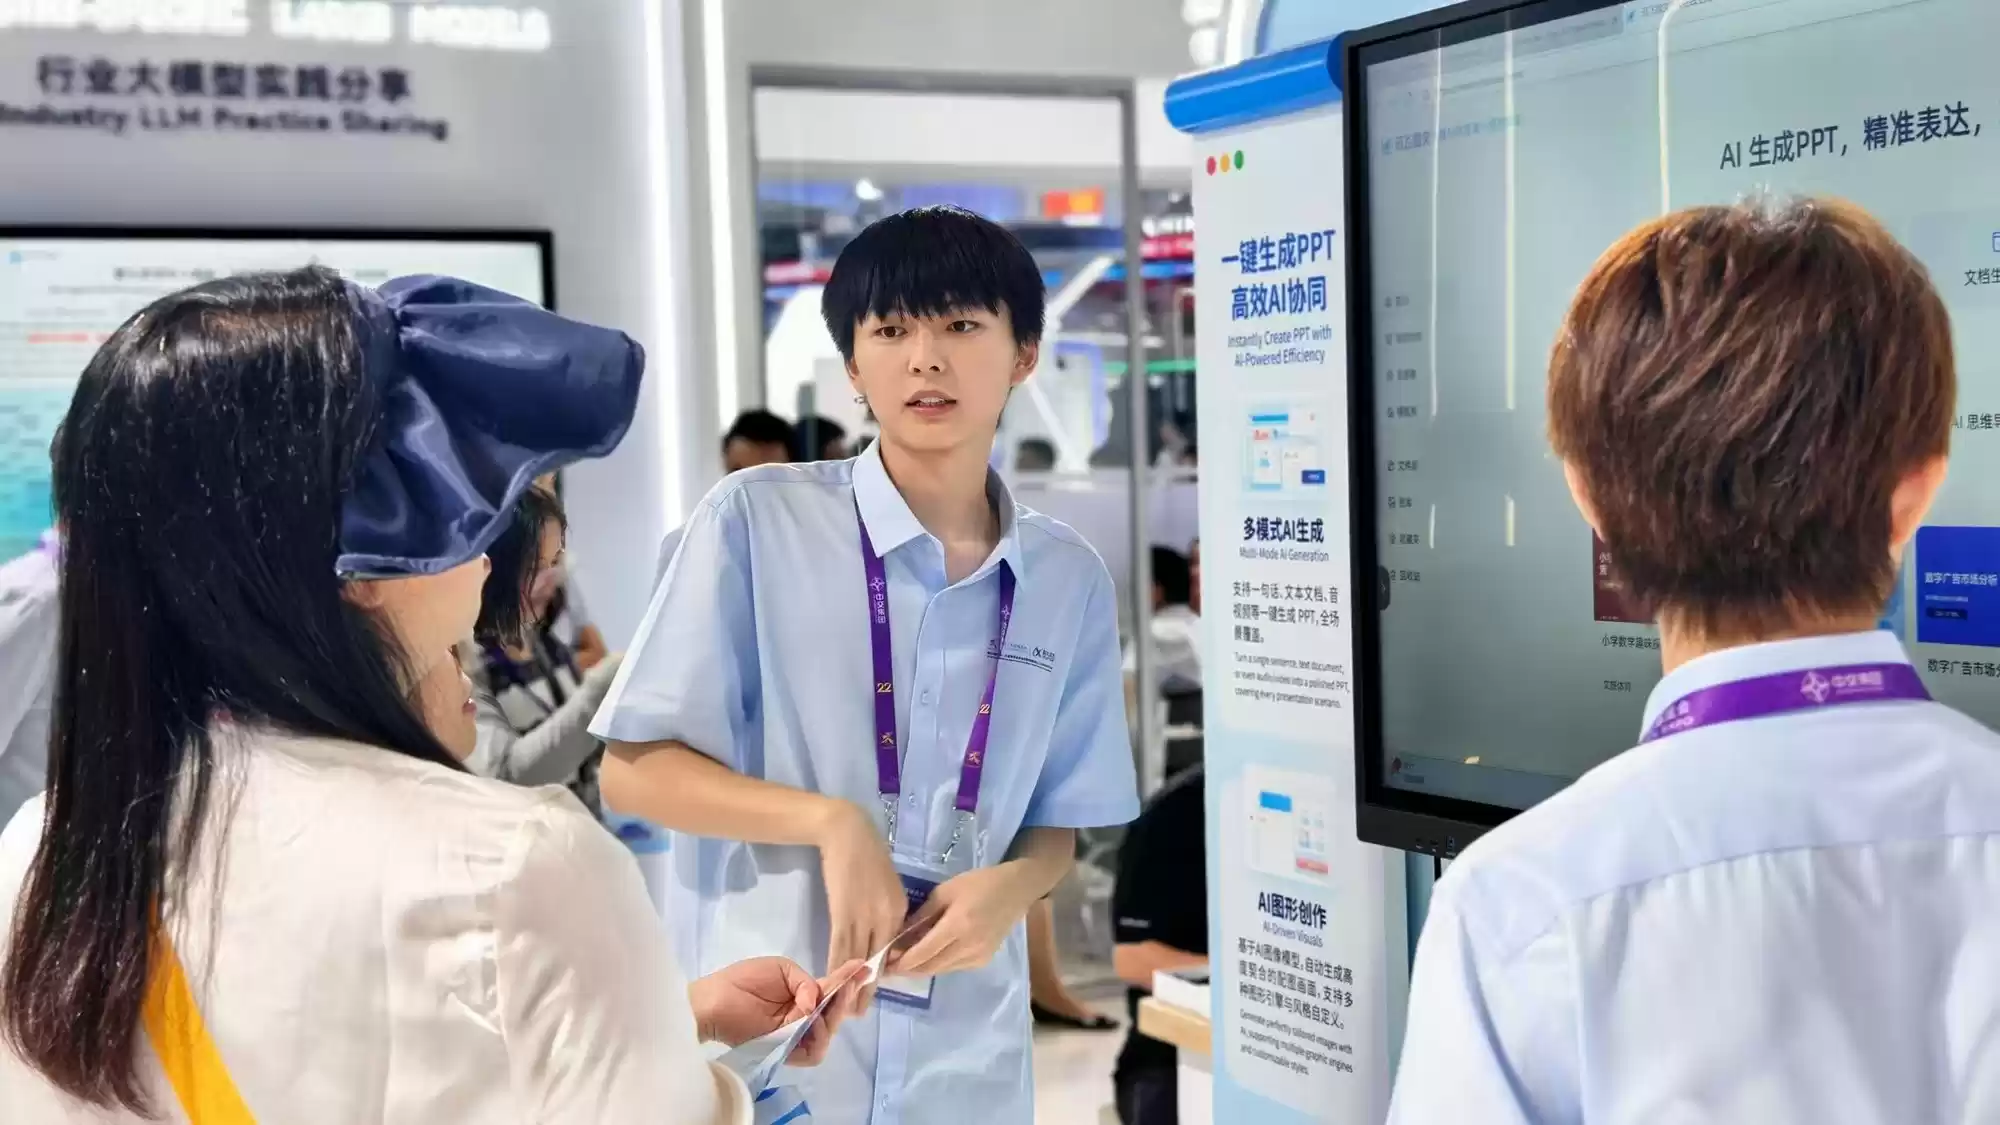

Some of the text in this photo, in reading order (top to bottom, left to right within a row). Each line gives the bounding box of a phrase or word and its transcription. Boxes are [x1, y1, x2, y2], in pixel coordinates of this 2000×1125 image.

[37, 55, 410, 102] 行业大模型实践分享
[138, 106, 201, 132] LLM
[213, 106, 330, 132] Practice
[341, 110, 449, 141] Sharing
[1720, 141, 1741, 169] AI
[1221, 229, 1336, 274] 一键生成PPT
[1231, 275, 1327, 321] 高效AI协同
[1228, 324, 1332, 349] Instantly Create PPT with
[1234, 347, 1326, 367] AI-Powered Efficiency
[1243, 516, 1324, 543] 多模式AI生成
[1288, 548, 1329, 562] Generation
[1232, 580, 1338, 604] 支持一句话、文本文档、音
[1924, 572, 1998, 587] 数字广告市场分析
[877, 682, 892, 693] 22
[978, 703, 991, 714] 22
[1258, 891, 1327, 930] AI图形创作
[1263, 919, 1323, 948] AI-Driven Visuals
